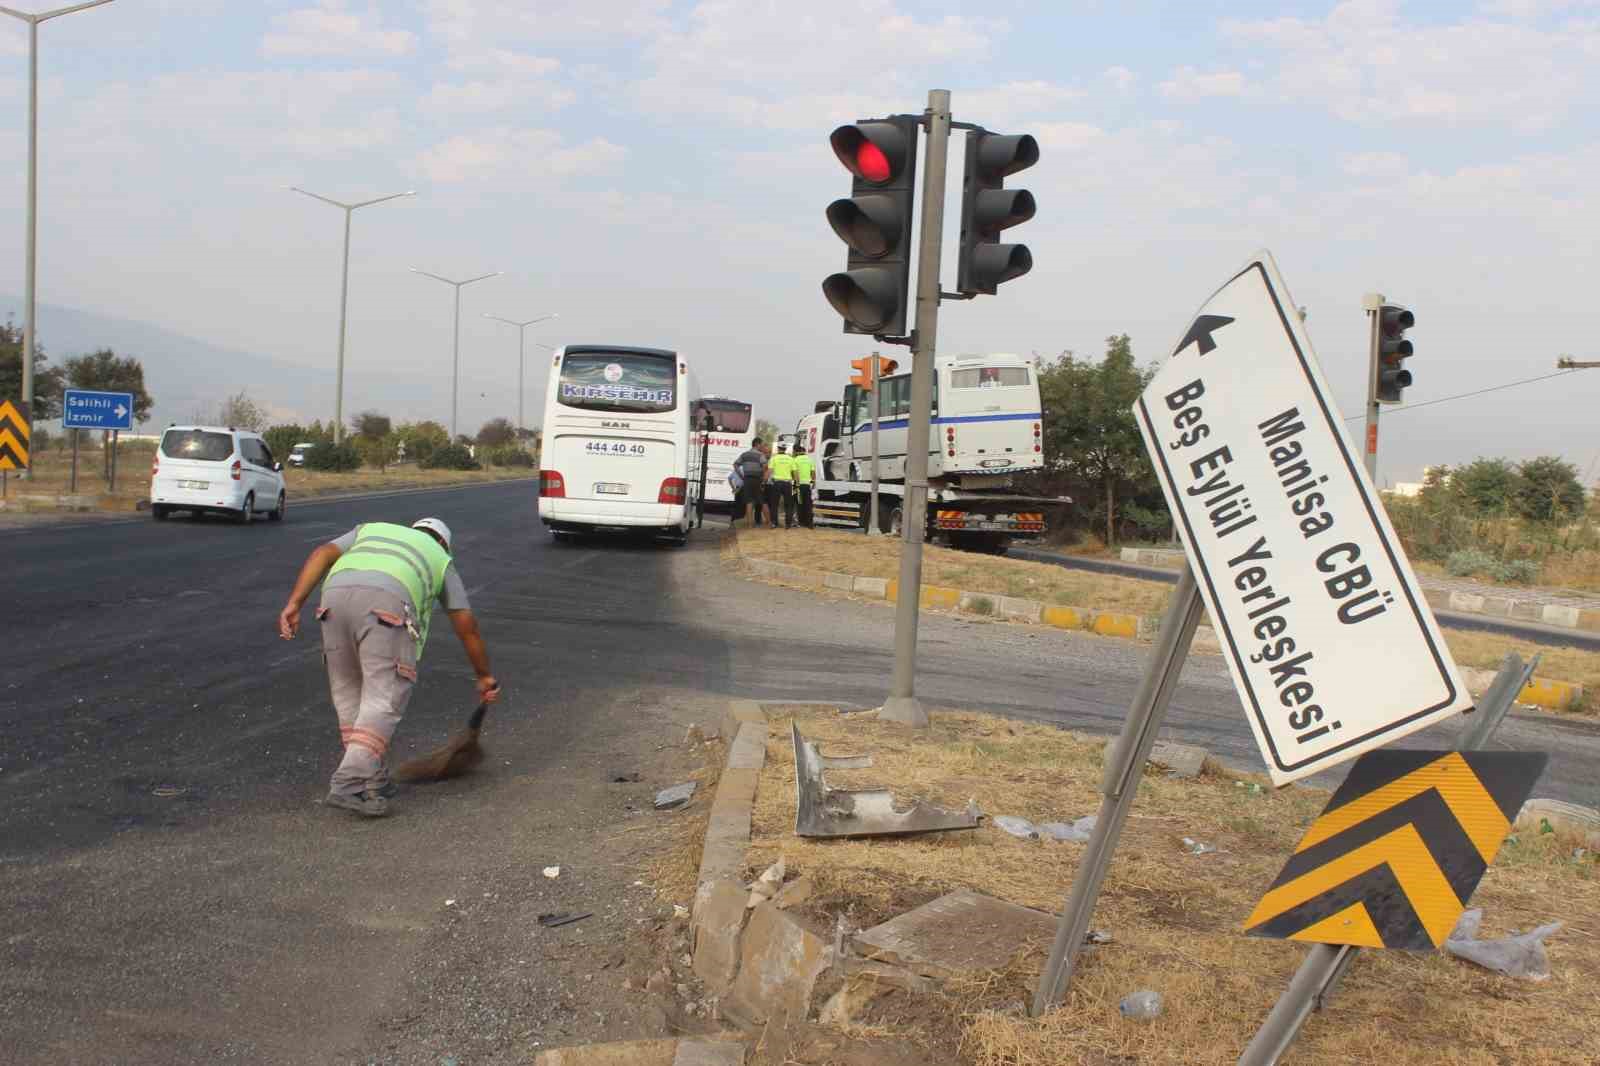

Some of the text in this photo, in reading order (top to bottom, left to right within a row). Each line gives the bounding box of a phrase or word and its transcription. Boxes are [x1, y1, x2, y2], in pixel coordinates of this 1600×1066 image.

[69, 396, 111, 409] Salihli
[585, 442, 607, 453] 444
[612, 444, 626, 454] 40
[630, 445, 645, 455] 40
[1165, 378, 1342, 744] Beş Eylül Yerleşkesi
[1257, 407, 1394, 625] Manisa CBÜ
